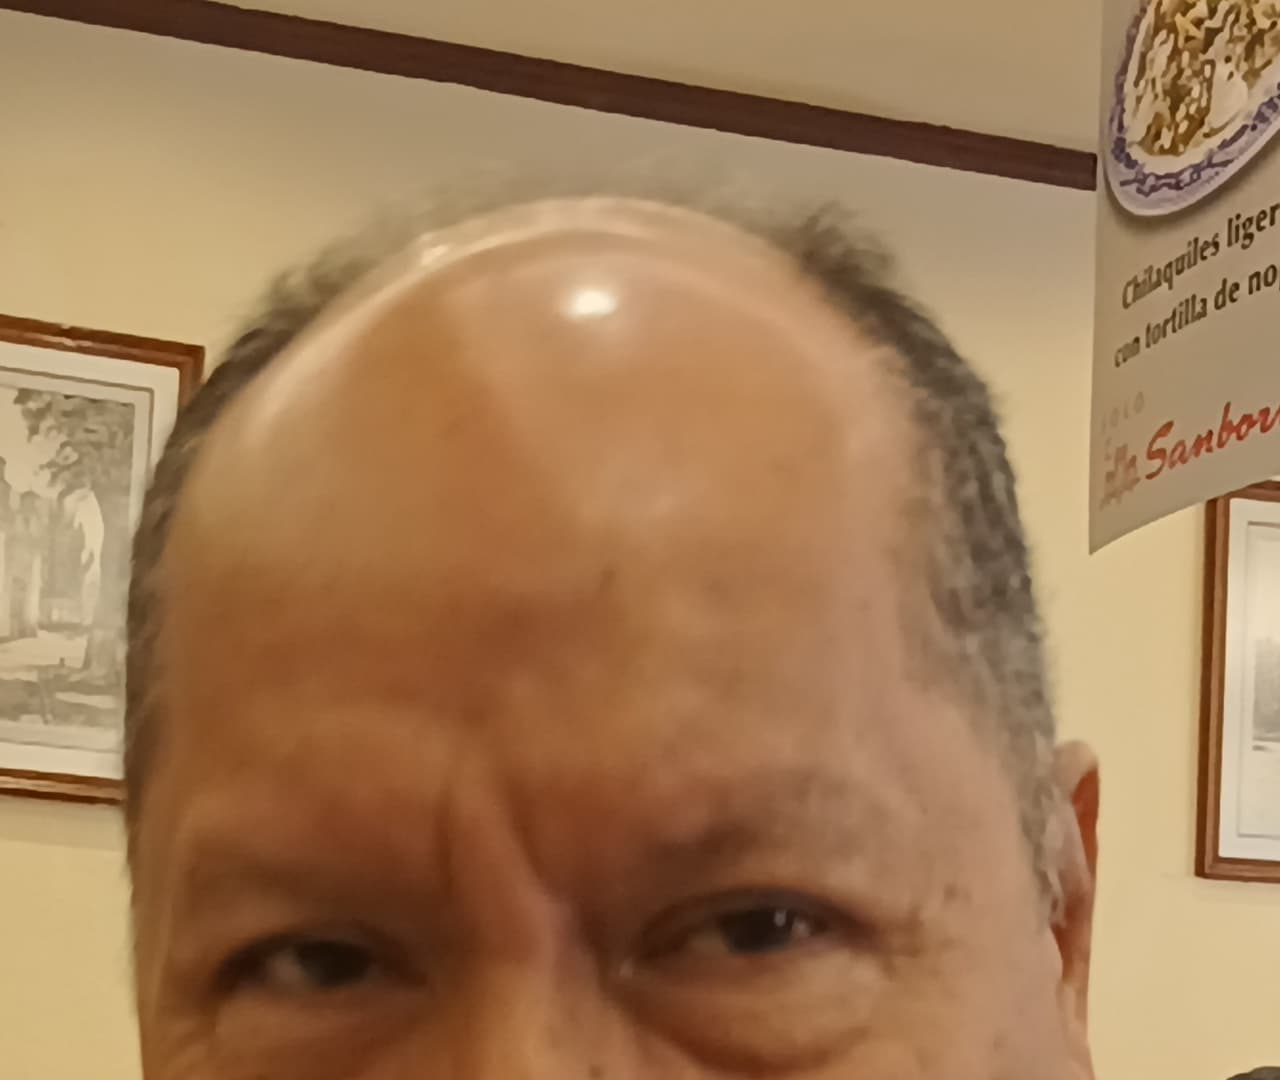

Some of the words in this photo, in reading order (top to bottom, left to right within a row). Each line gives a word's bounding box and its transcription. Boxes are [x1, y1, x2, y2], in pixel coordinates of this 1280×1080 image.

[1121, 232, 1220, 310] Chilaquiles
[1114, 336, 1141, 368] con
[1145, 293, 1208, 349] tortilla
[1213, 277, 1240, 311] de
